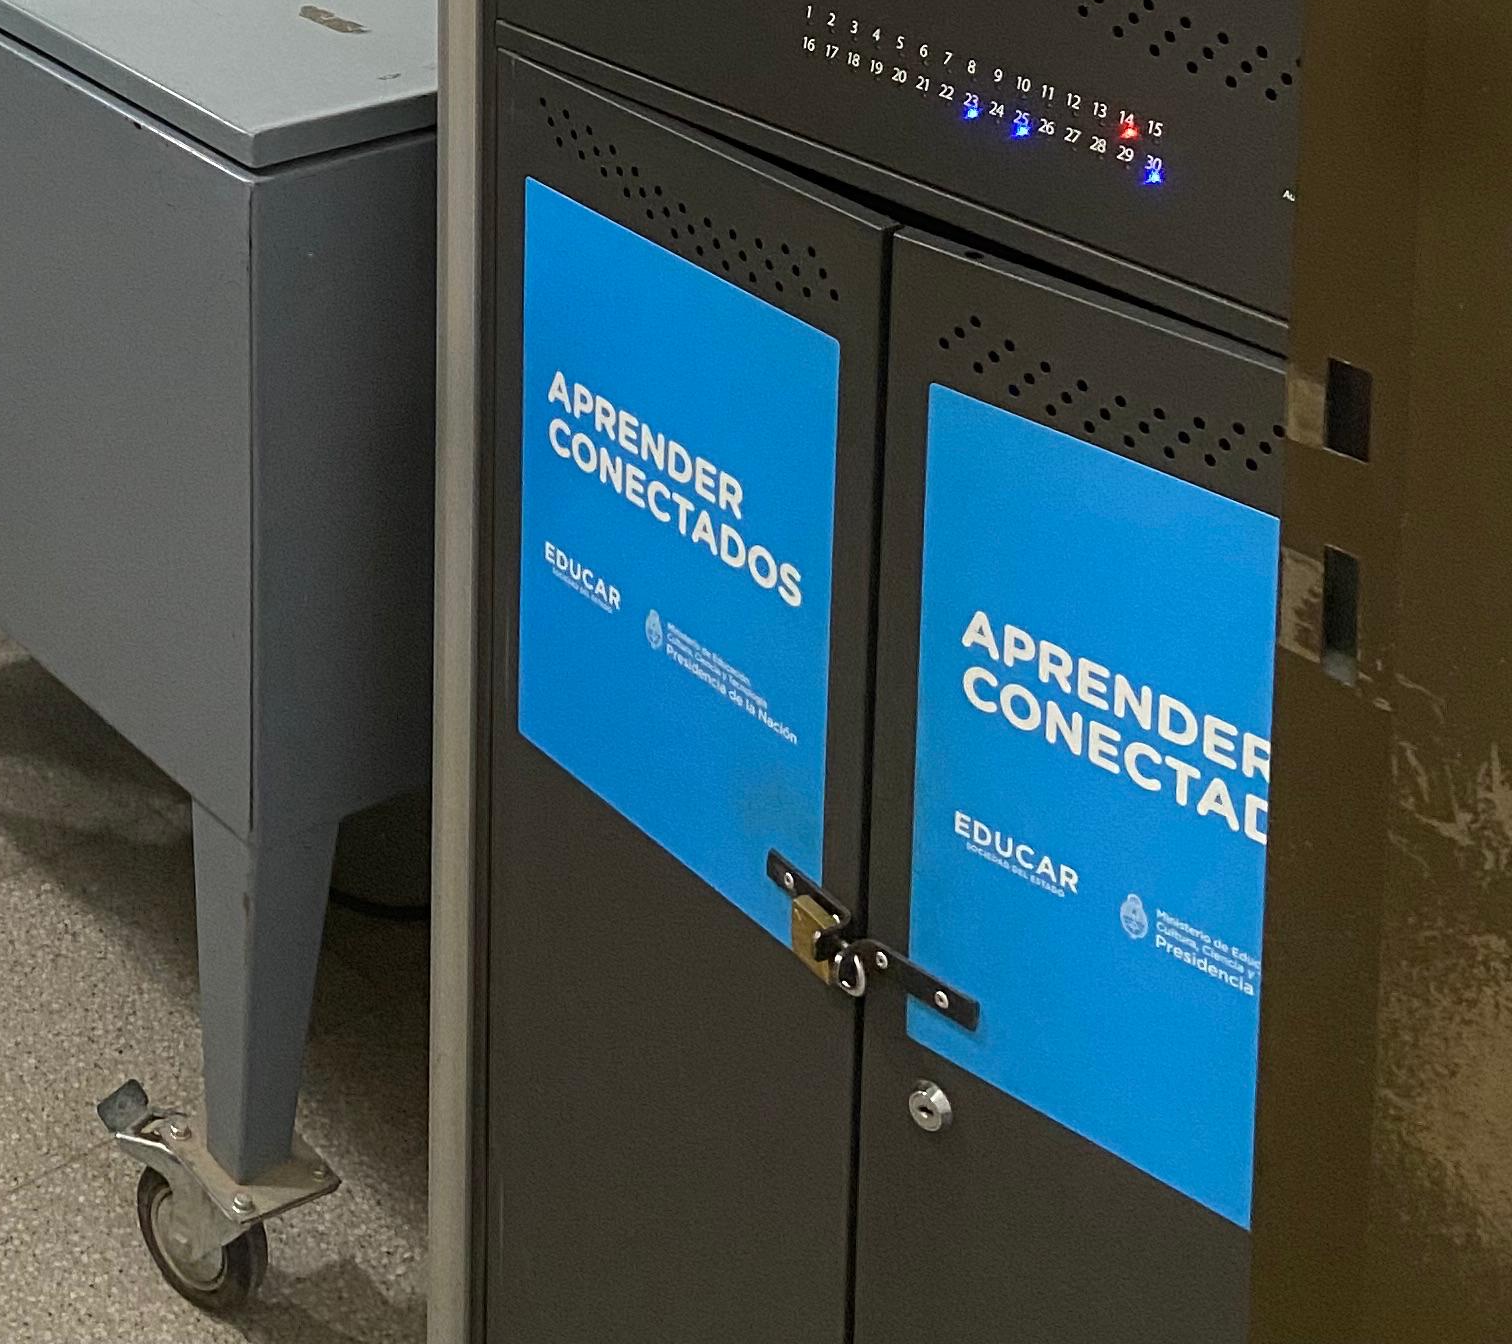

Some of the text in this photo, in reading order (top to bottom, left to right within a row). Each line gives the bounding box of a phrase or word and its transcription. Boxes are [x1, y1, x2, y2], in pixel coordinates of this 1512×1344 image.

[802, 36, 1162, 171] 16 17 18 19 20 21 22 23 24 25 26 27 28 29 30
[807, 6, 1163, 137] 1 2 3 4 5 6 7 8 9 10 11 12 13 14 15
[547, 370, 743, 520] APRENDER
[548, 418, 802, 607] CONECTADOS
[545, 540, 621, 611] EDUCAR
[666, 643, 798, 745] Presidencia de la Nación
[962, 610, 1271, 784] APRENDER
[954, 809, 1079, 895] EDUCAR
[1011, 865, 1029, 880] DEL
[1030, 875, 1065, 898] ESTADO
[1155, 934, 1255, 996] Presidencia
[1156, 908, 1229, 954] Ministerio de
[1202, 945, 1245, 974] Ciencia
